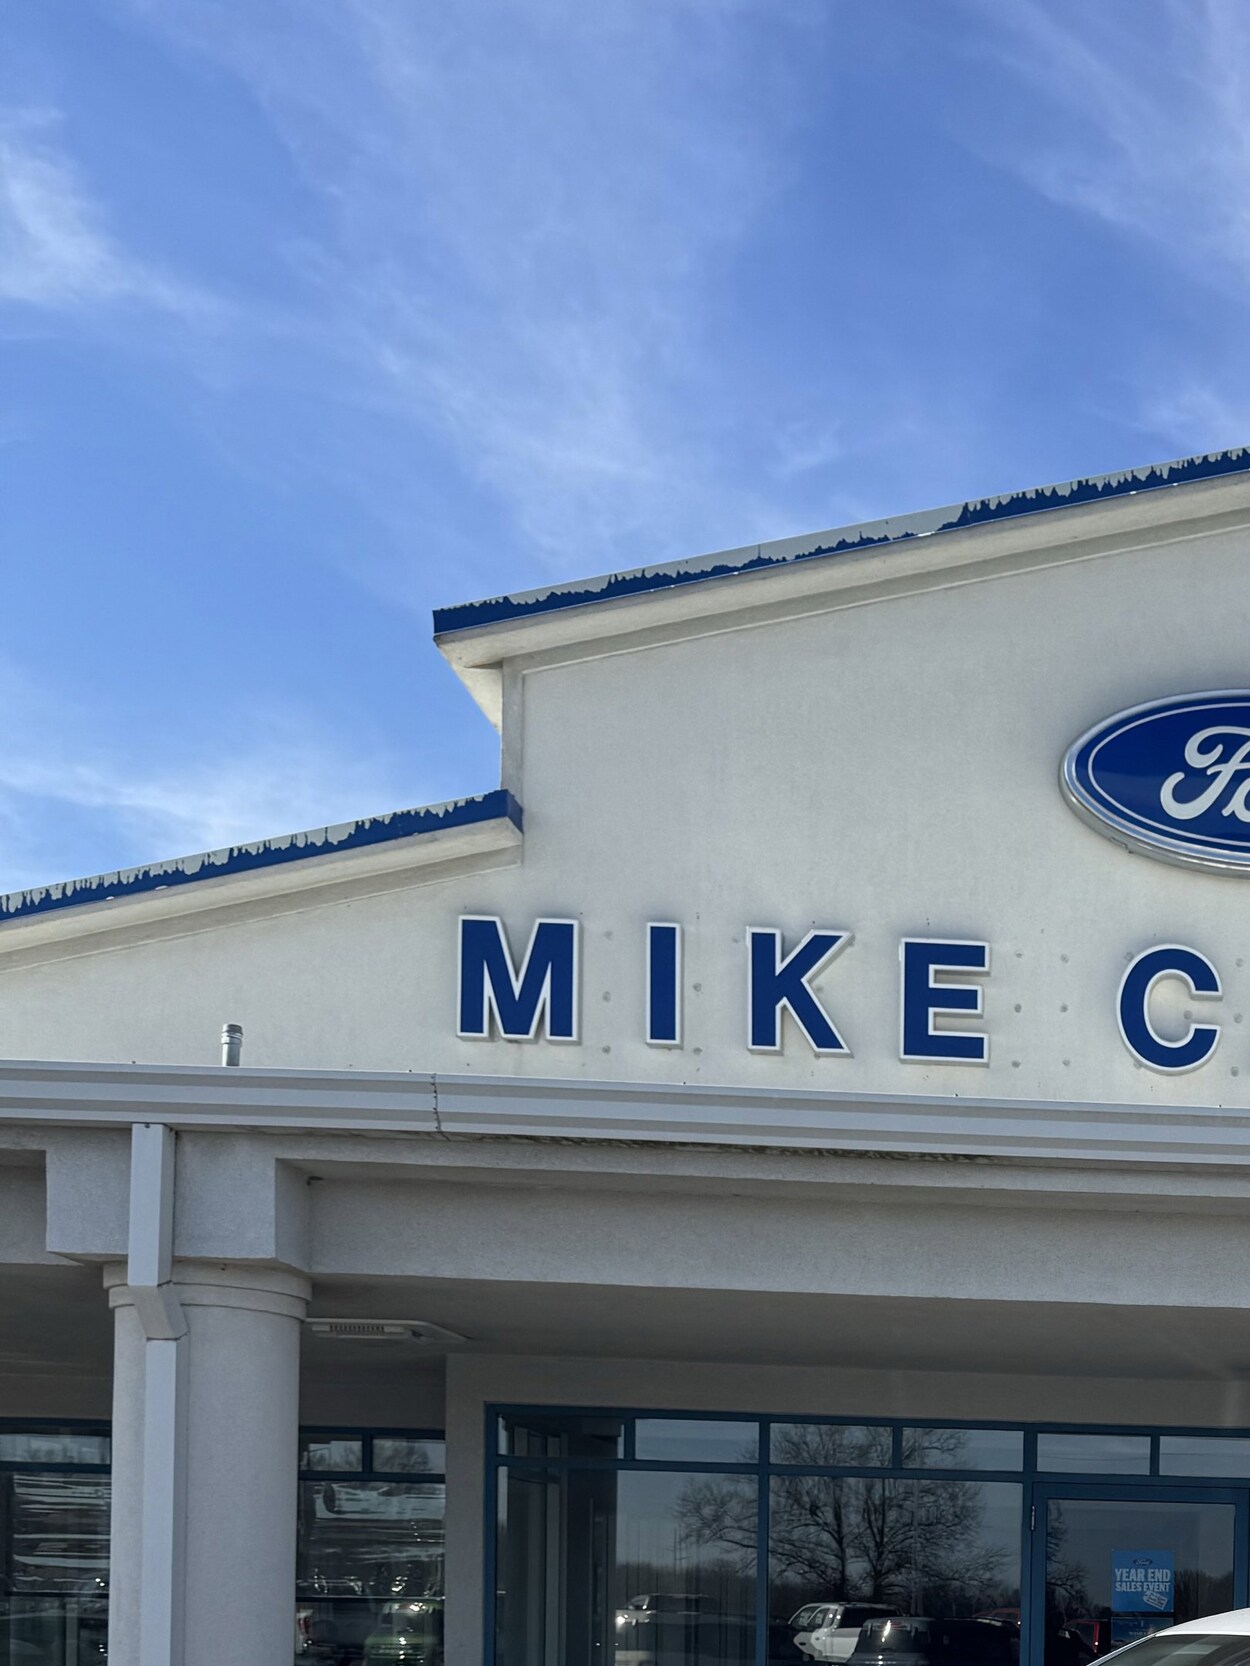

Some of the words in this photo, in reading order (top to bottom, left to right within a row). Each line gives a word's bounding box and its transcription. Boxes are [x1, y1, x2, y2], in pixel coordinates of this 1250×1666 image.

[456, 914, 991, 1065] MIKE
[1115, 1568, 1145, 1581] YEAR
[1147, 1569, 1171, 1582] END
[1115, 1582, 1142, 1592] SALES
[1143, 1582, 1171, 1592] EVENT
